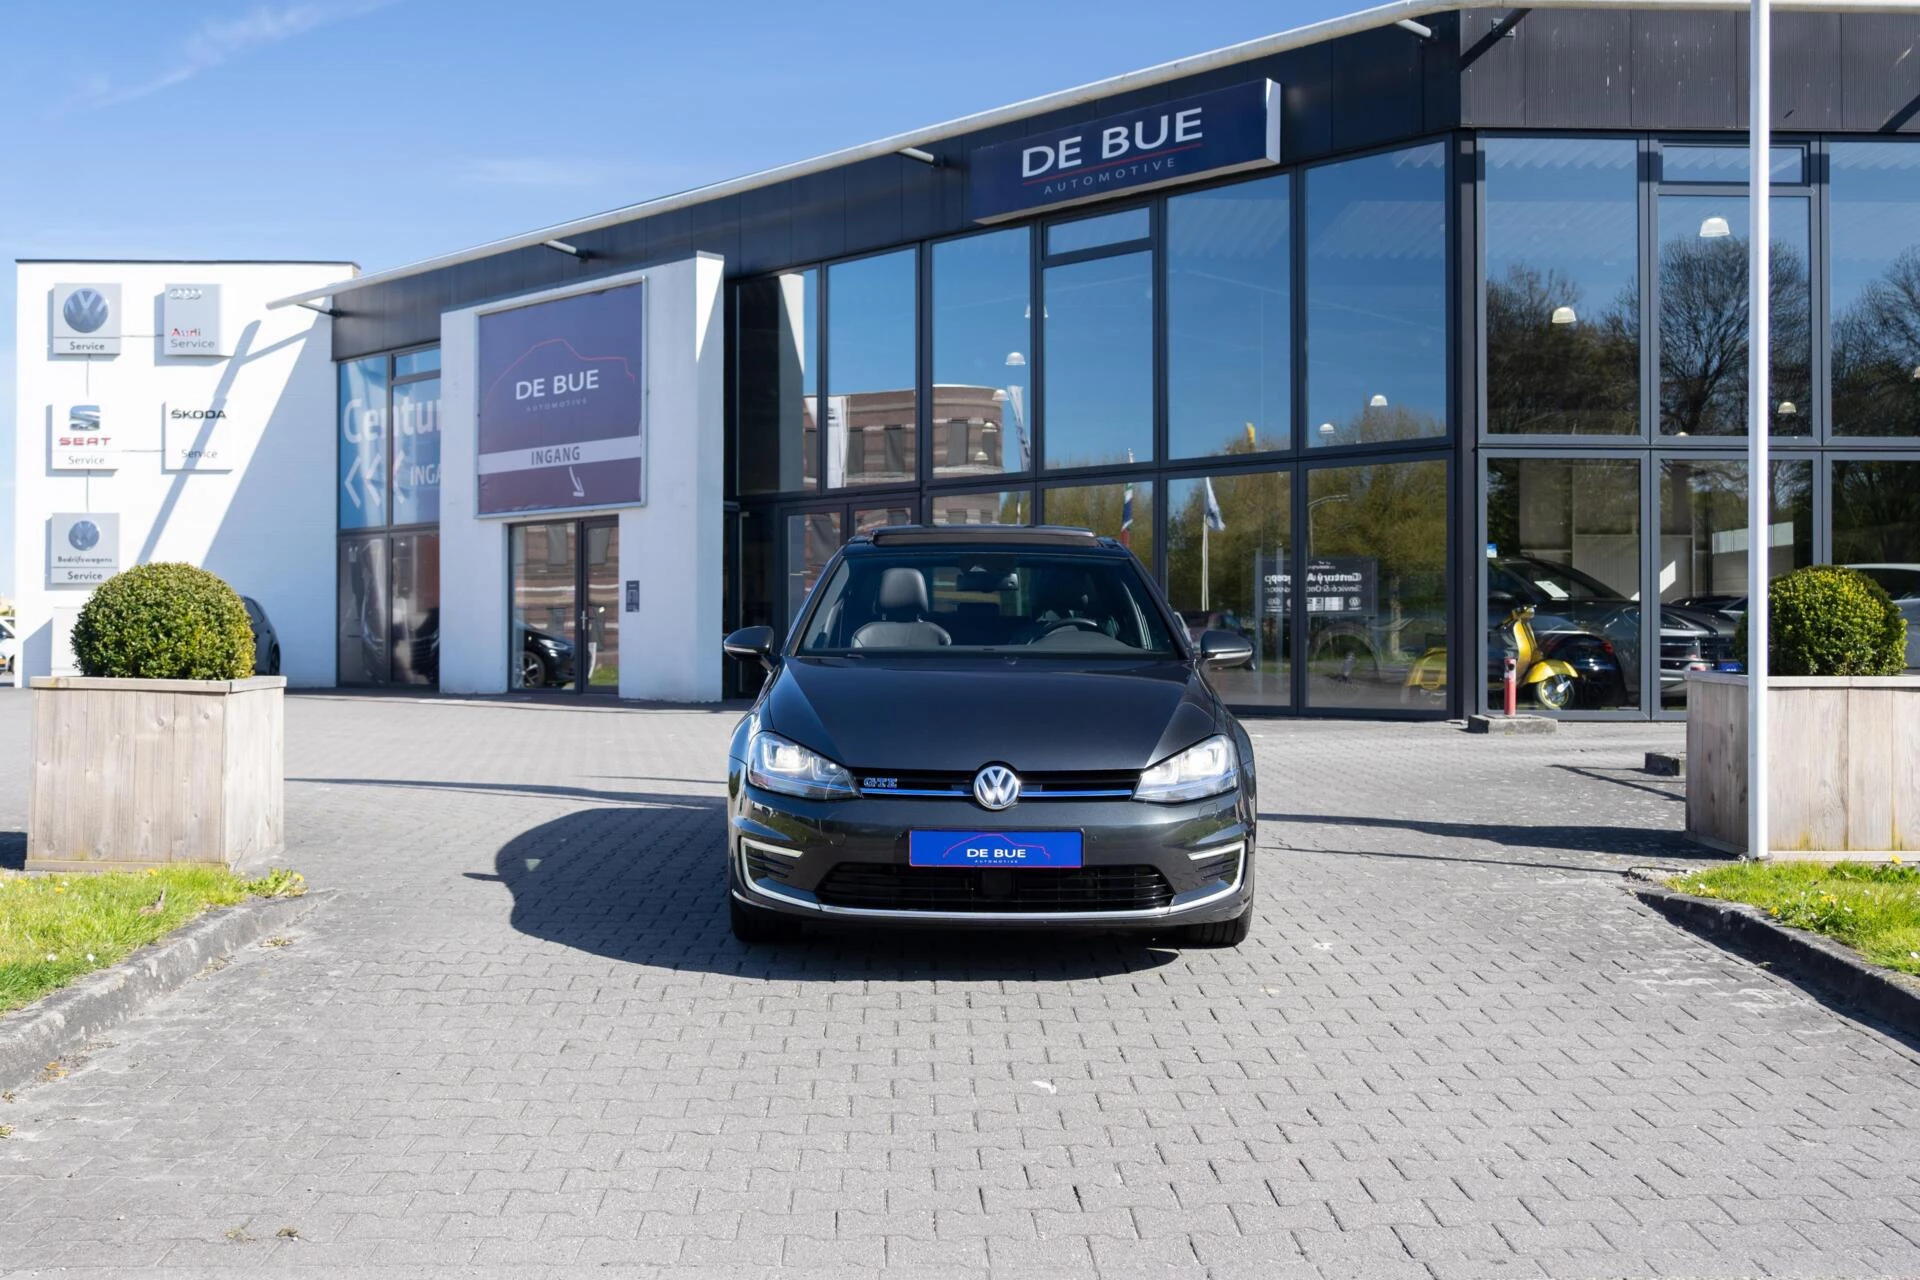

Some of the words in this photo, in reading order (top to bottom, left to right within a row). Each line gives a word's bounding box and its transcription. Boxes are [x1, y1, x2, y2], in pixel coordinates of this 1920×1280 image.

[1021, 135, 1083, 179] DE
[1101, 107, 1204, 160] BUE
[1044, 157, 1176, 195] AUTOMOTIVE
[170, 327, 201, 337] Audi
[69, 341, 105, 351] Service
[170, 338, 215, 348] Service
[515, 378, 546, 401] DE
[553, 369, 600, 395] BUE
[58, 437, 111, 446] SEAT
[67, 455, 105, 465] Service
[531, 446, 581, 466] INGANG
[67, 571, 103, 580] Service
[863, 777, 898, 788] GTE
[966, 848, 989, 858] DE
[993, 848, 1027, 858] BUE
